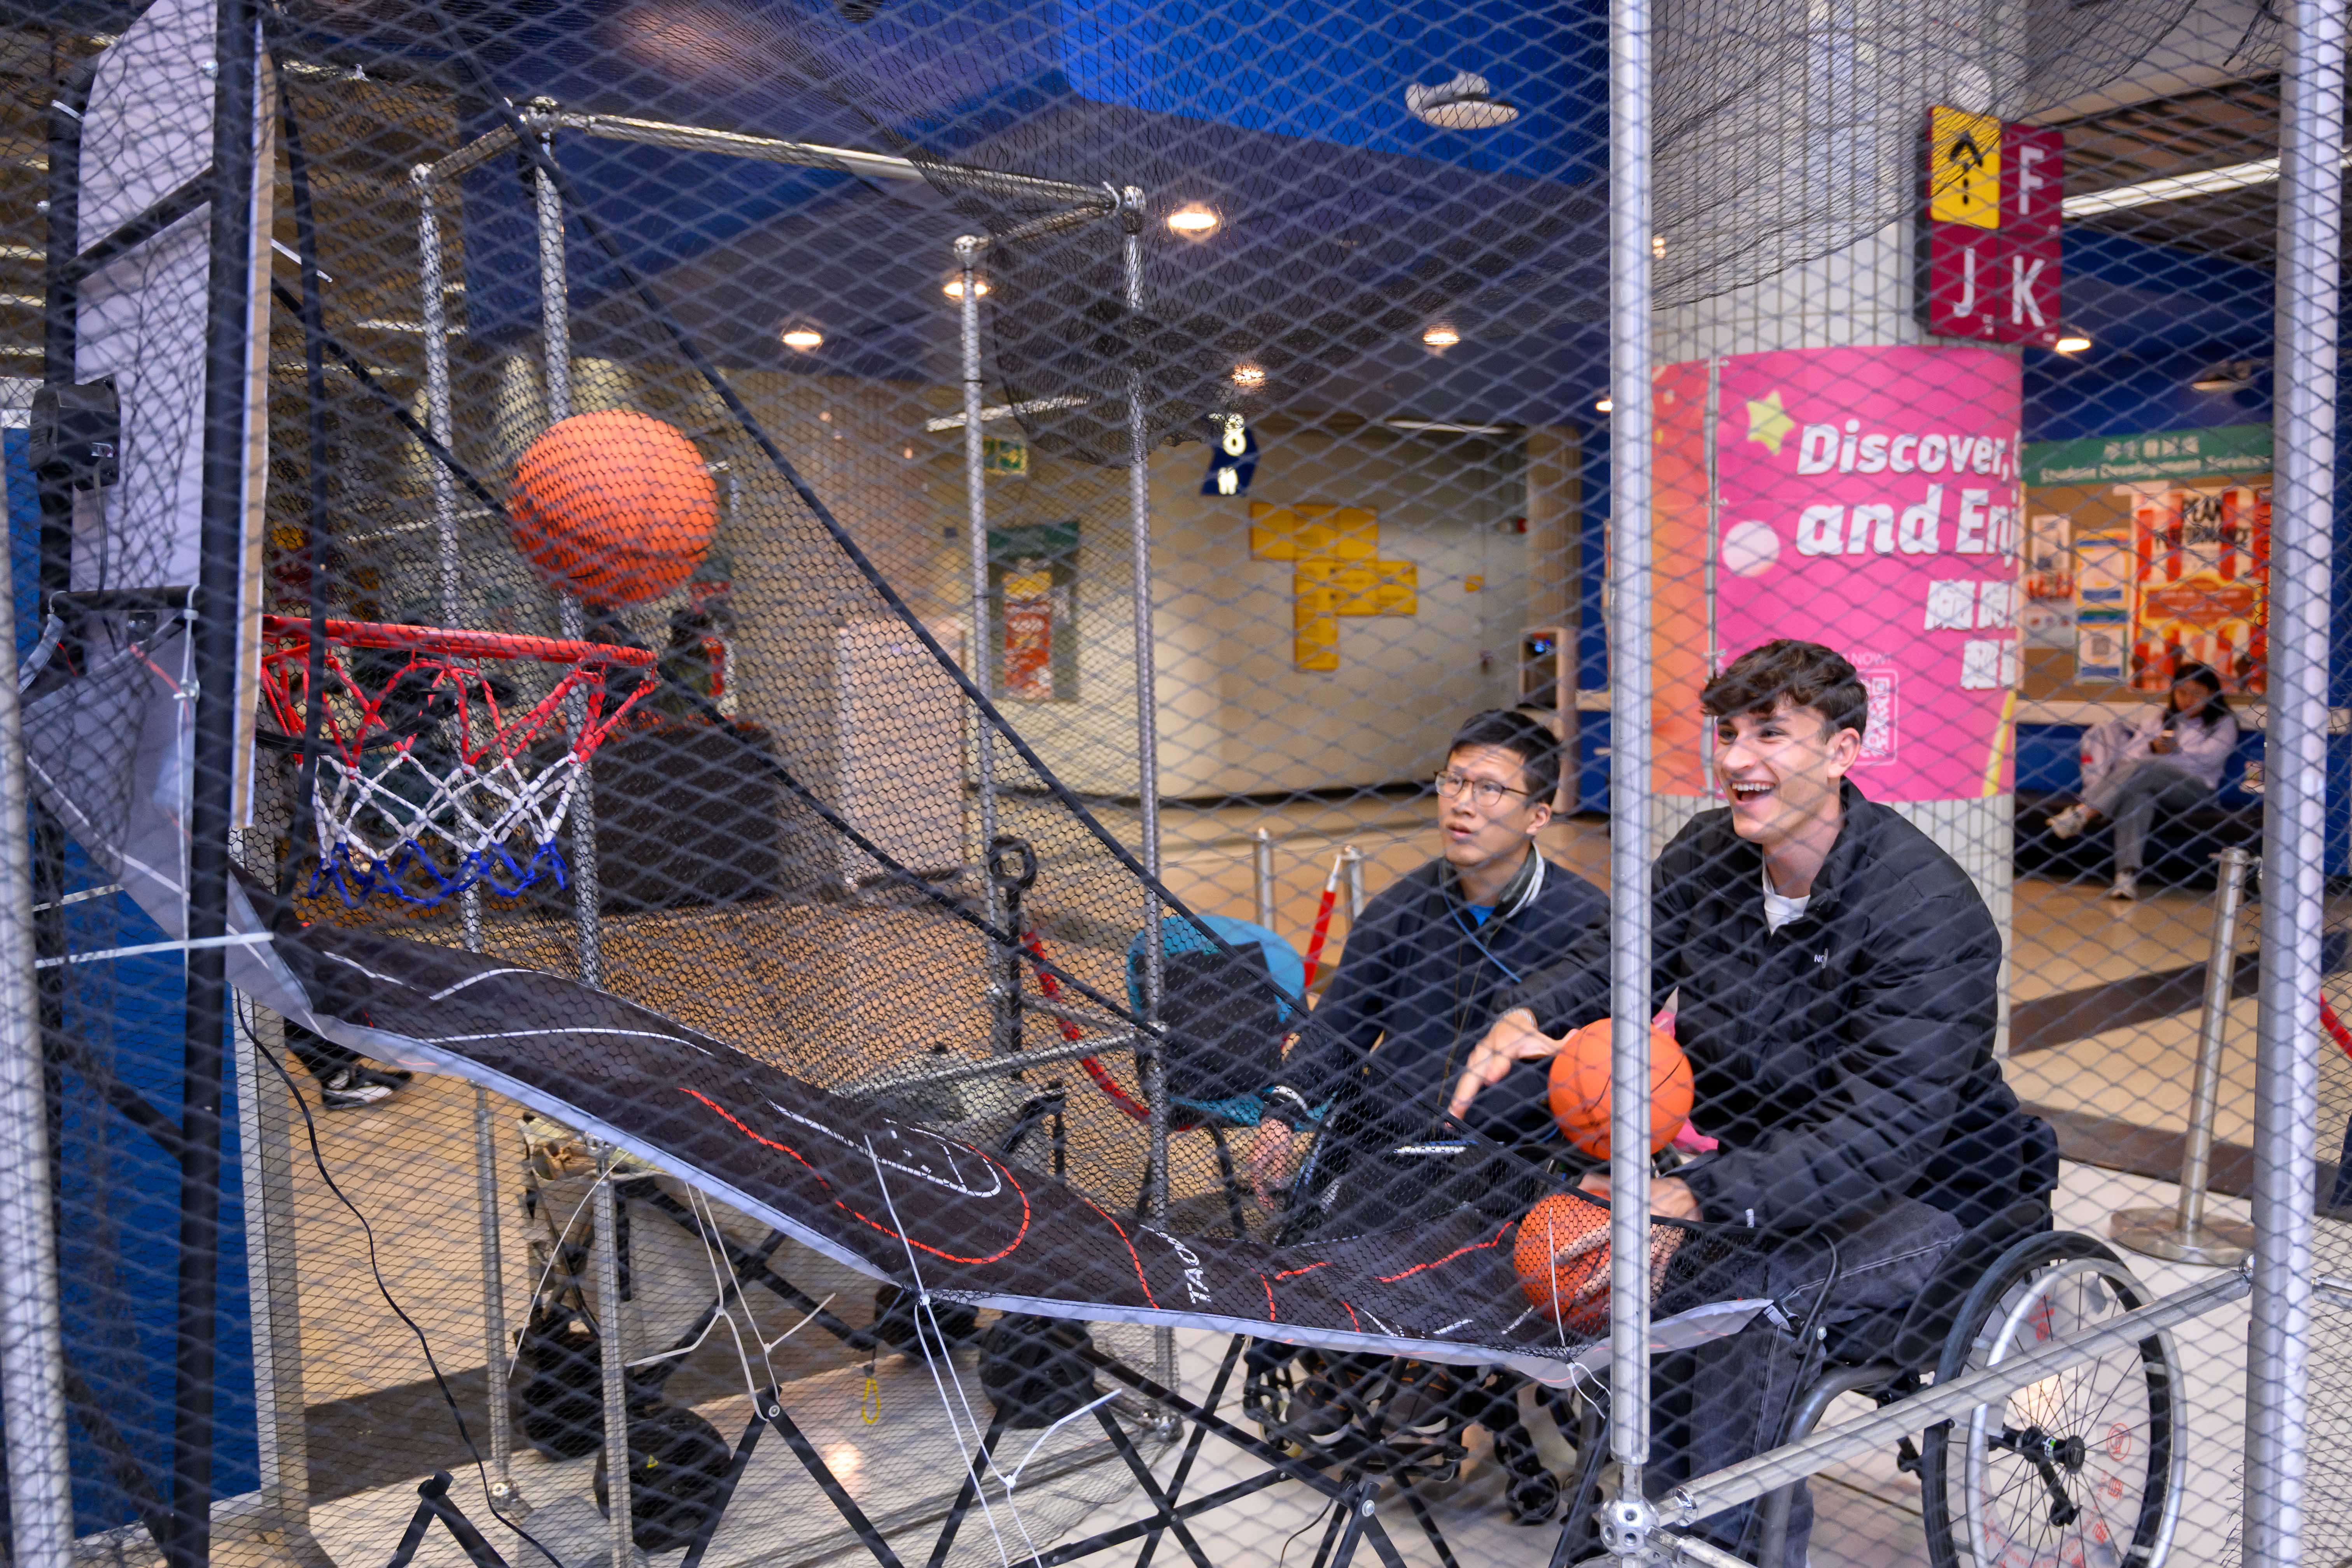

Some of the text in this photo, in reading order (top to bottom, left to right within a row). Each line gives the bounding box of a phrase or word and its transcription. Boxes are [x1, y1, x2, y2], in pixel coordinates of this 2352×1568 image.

[2019, 145, 2044, 215] F
[1953, 248, 2046, 327] J K
[1797, 419, 2010, 481] Discover,
[1796, 484, 1943, 555] and
